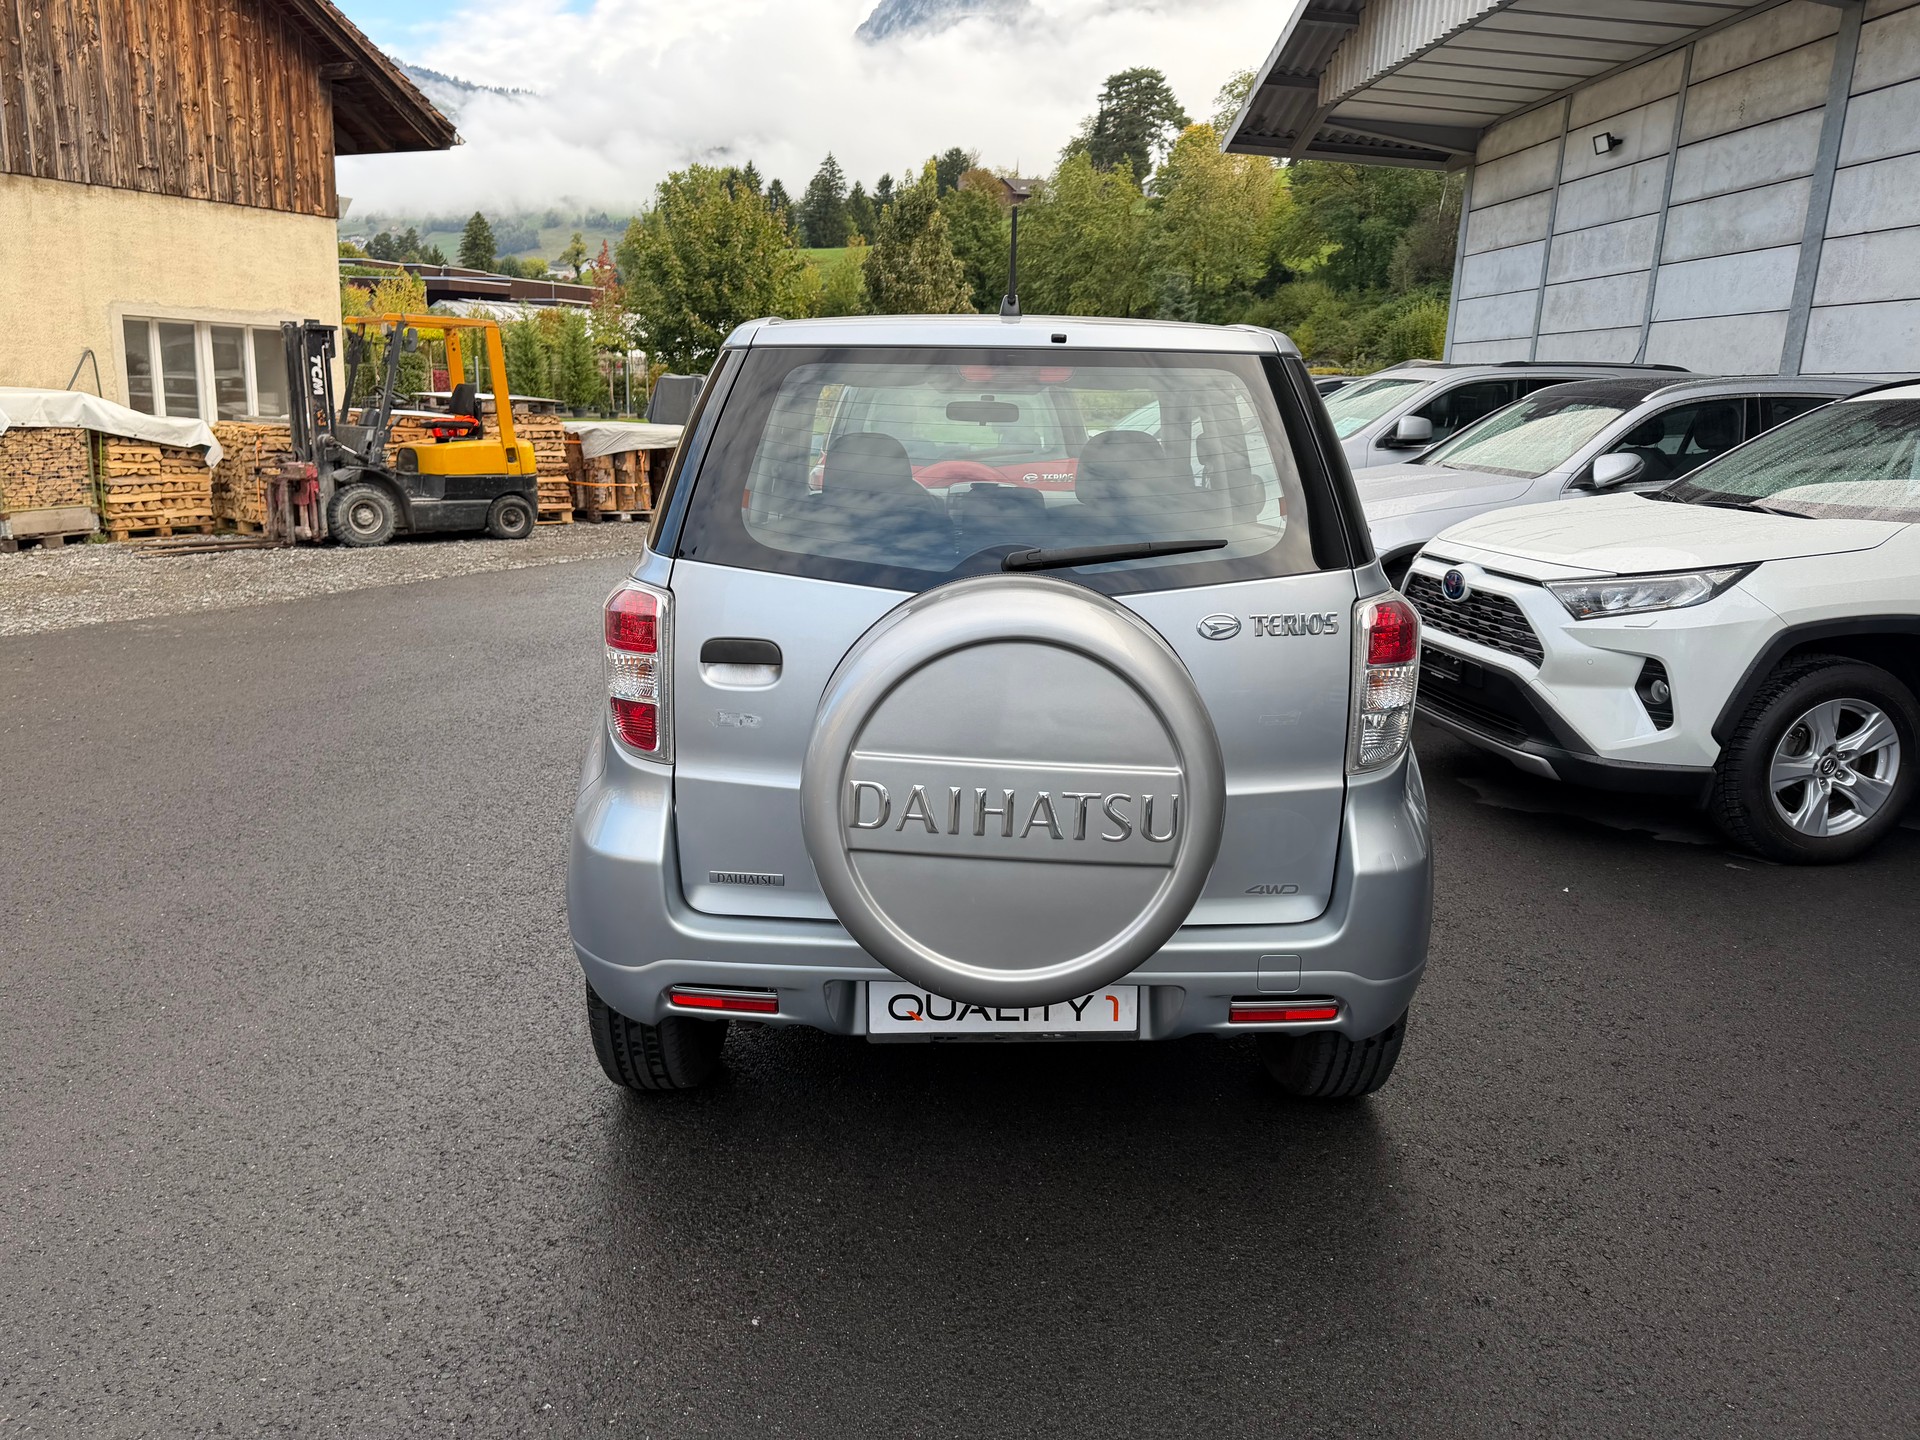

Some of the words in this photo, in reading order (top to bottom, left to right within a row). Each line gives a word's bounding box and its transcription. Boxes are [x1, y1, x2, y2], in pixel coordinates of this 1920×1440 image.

[310, 355, 325, 395] TCM
[1249, 611, 1340, 637] TERIOS
[849, 780, 1180, 843] DAIHATSU
[717, 872, 776, 887] DAIHATSU
[1245, 884, 1299, 895] 4WD
[1105, 994, 1119, 1022] 1
